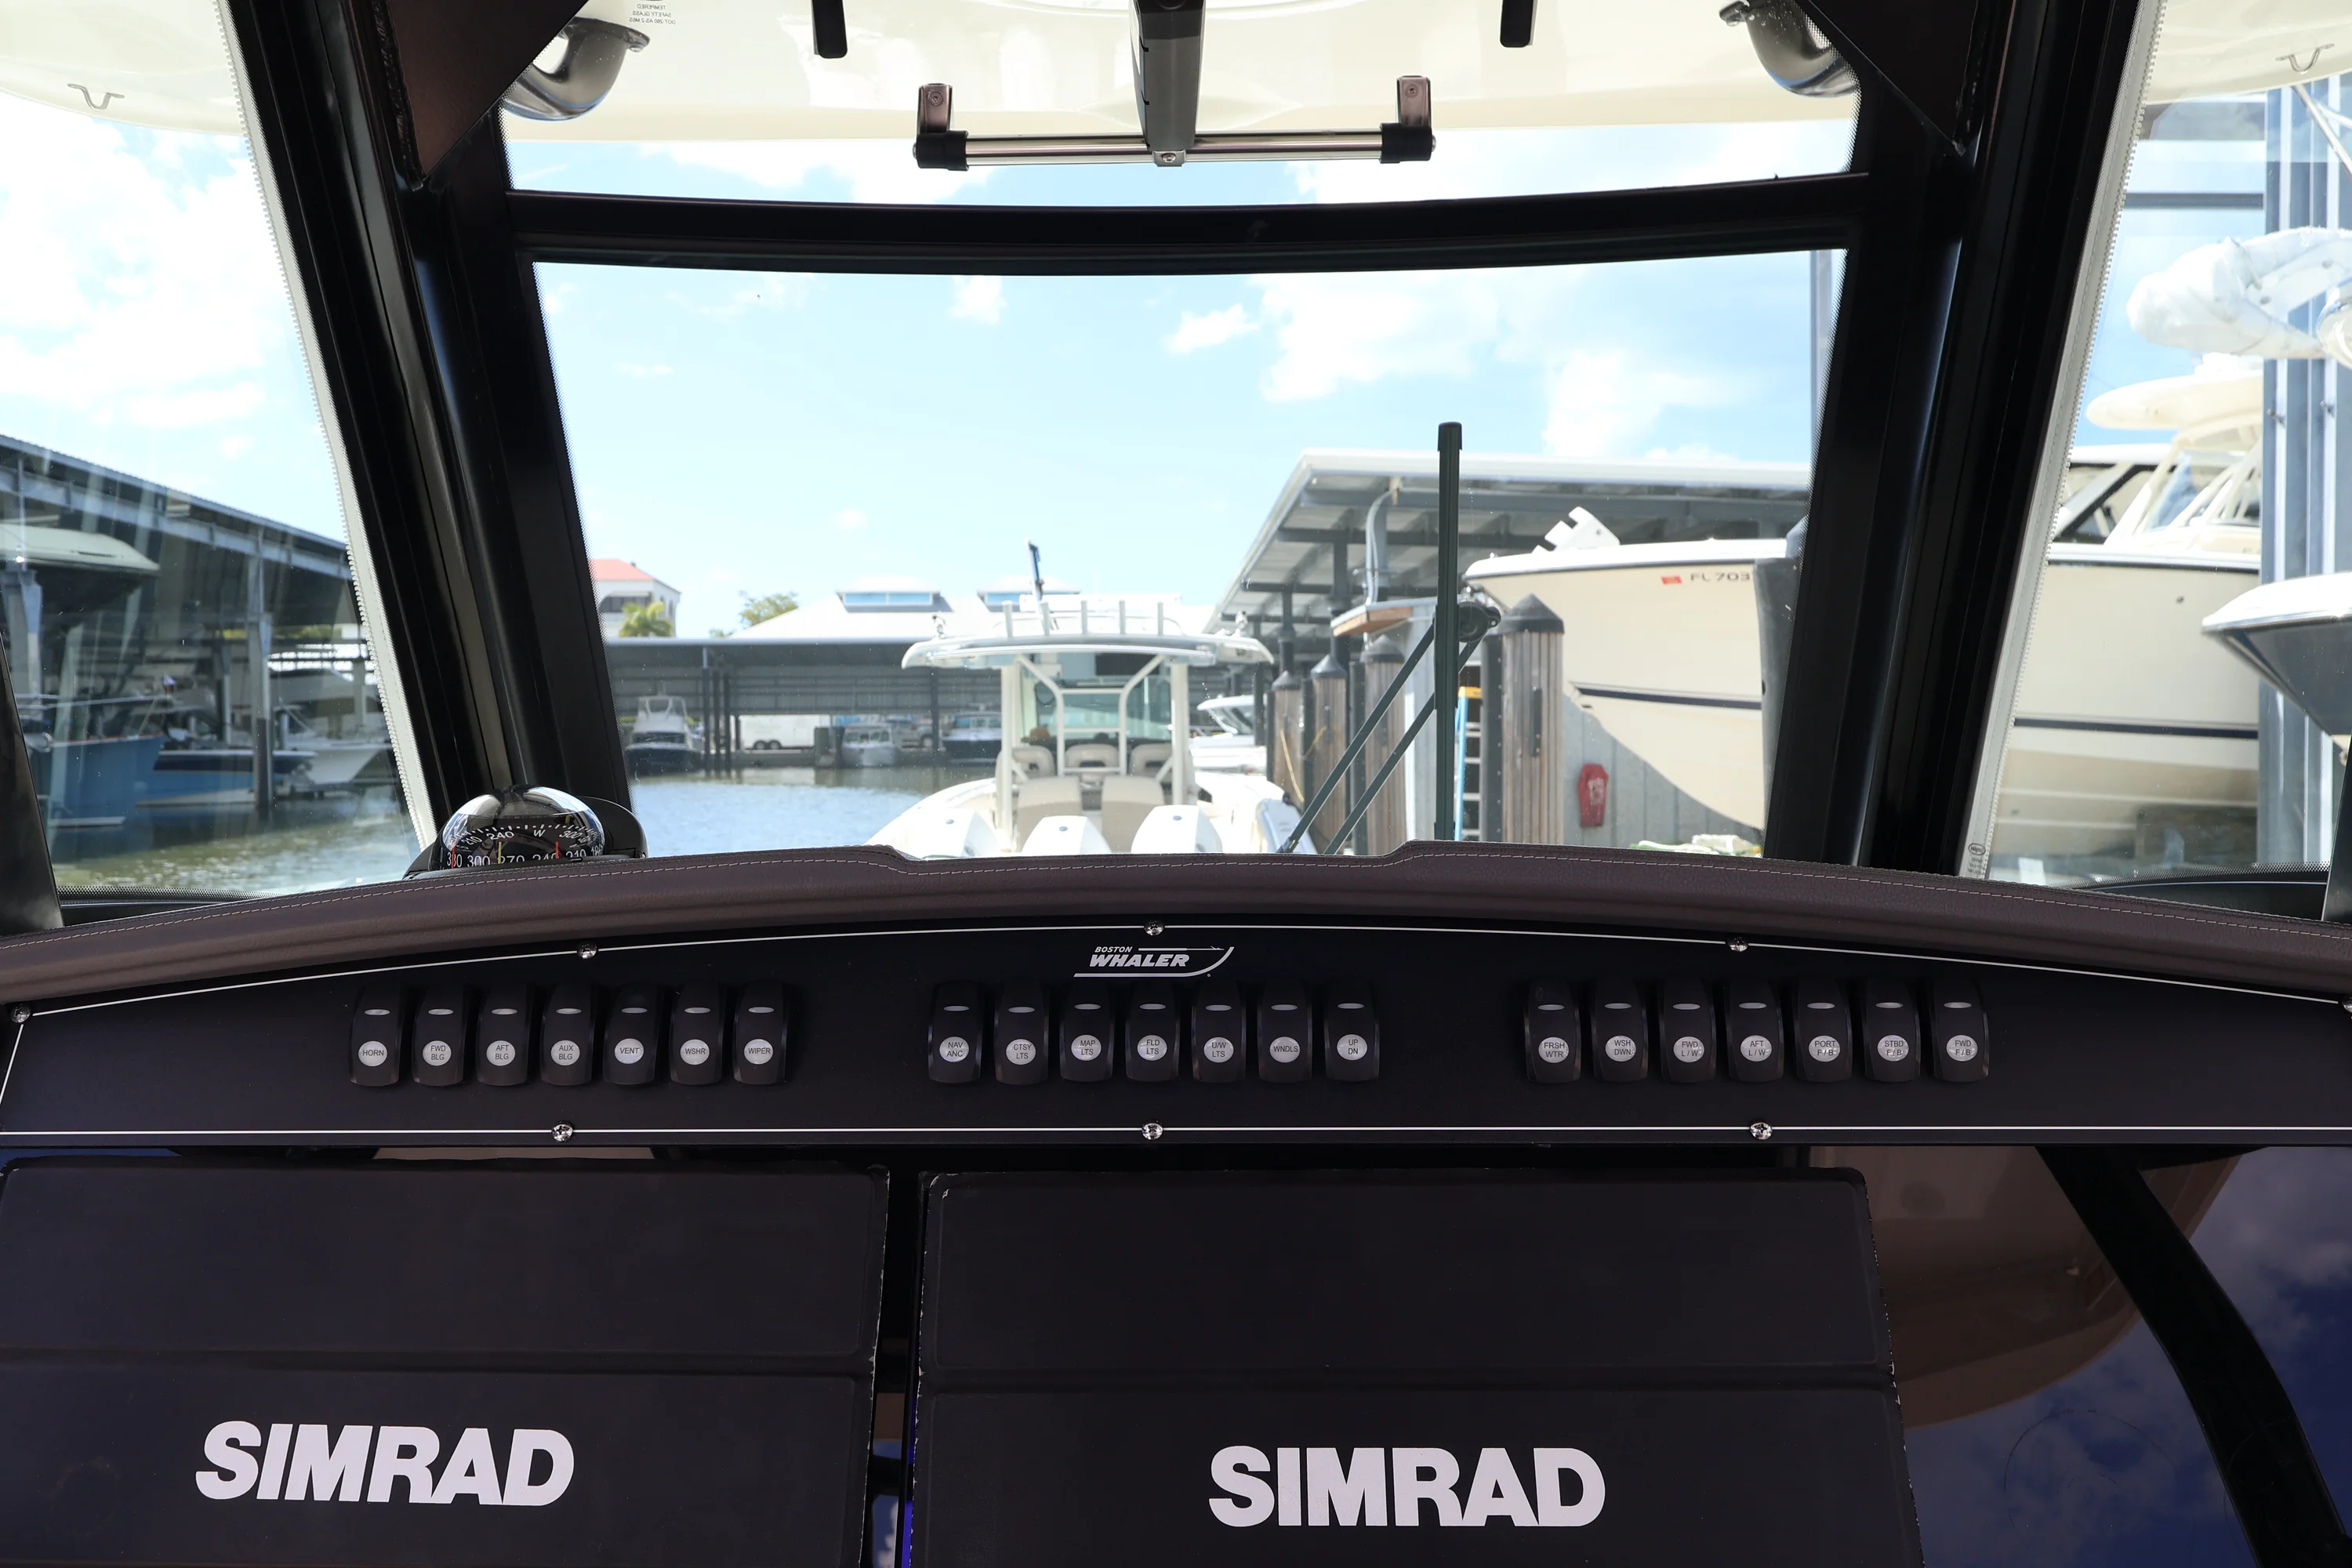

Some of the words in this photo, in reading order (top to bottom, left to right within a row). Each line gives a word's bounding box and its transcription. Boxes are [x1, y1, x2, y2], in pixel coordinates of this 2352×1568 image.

[1690, 572, 1711, 583] FL
[1715, 572, 1751, 582] 703
[461, 836, 483, 845] 210
[486, 831, 515, 840] 240
[559, 830, 583, 839] 300
[467, 855, 491, 867] 300
[1089, 954, 1190, 967] WHALER
[195, 1421, 575, 1506] SIMRAD
[1208, 1445, 1606, 1527] SIMRAD
